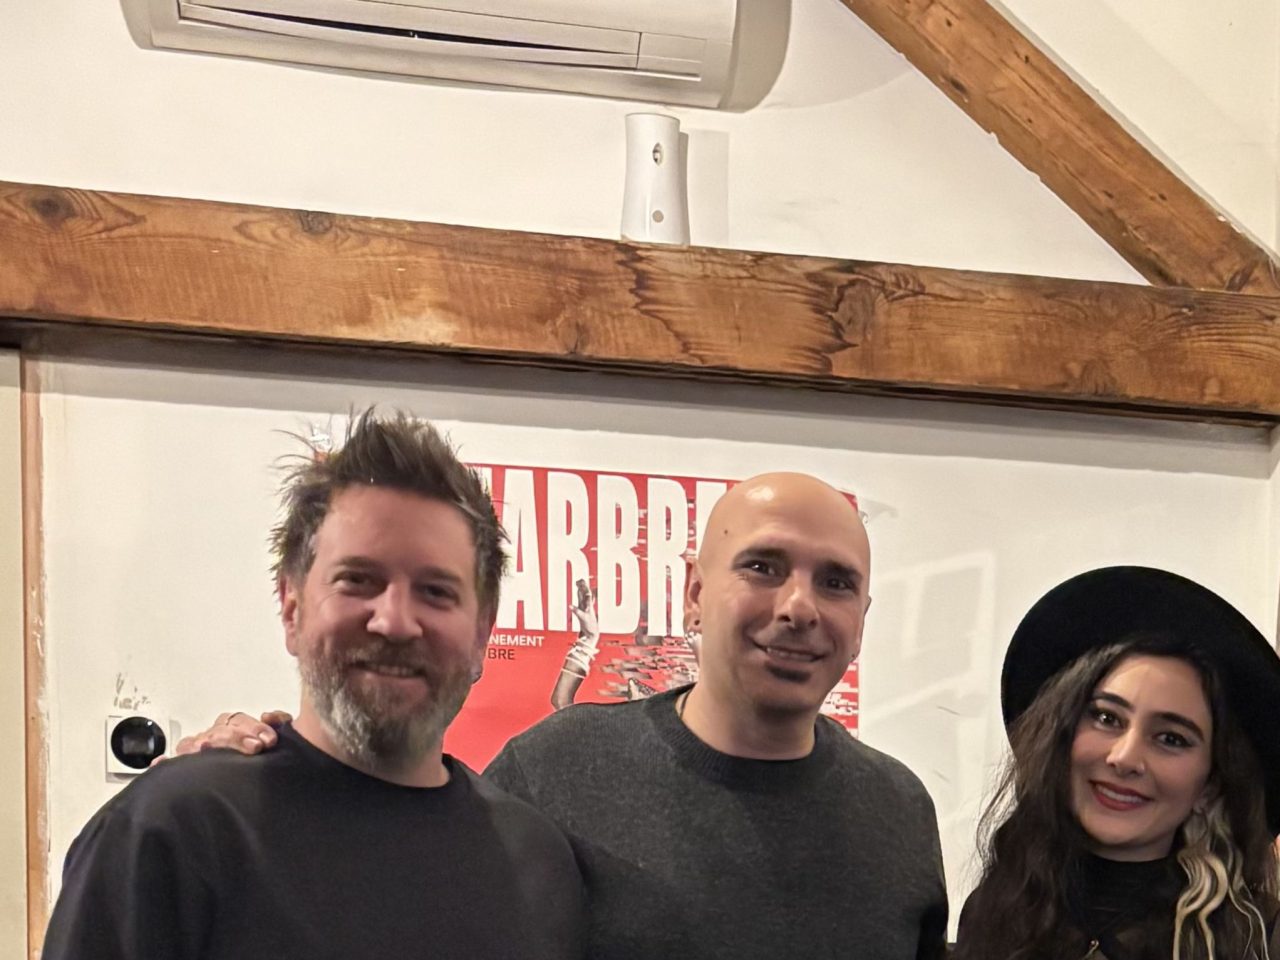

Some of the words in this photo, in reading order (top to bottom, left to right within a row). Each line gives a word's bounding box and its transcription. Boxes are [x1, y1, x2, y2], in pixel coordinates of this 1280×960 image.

[466, 466, 728, 637] ARBR
[489, 634, 545, 647] NEMENT
[487, 648, 515, 660] BRE
